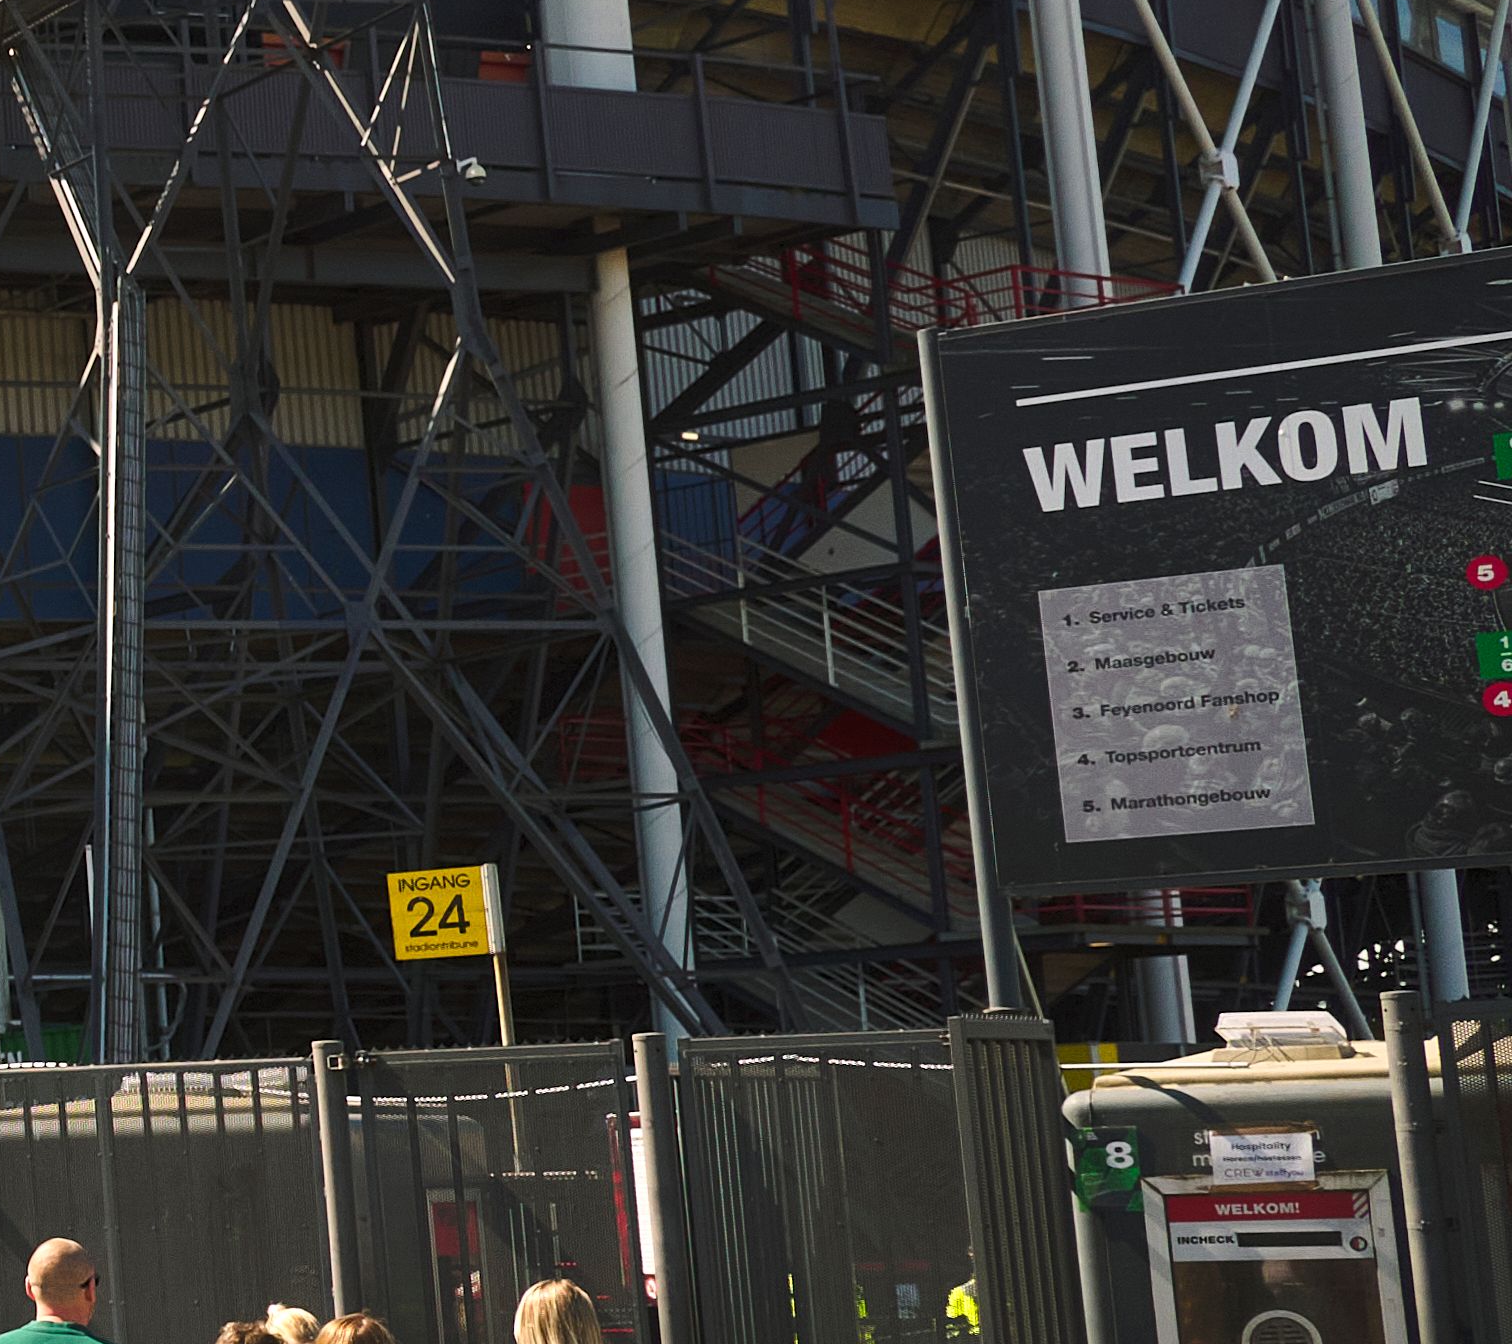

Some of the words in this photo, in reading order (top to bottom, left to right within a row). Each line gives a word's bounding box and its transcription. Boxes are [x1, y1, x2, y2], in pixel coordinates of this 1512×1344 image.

[1022, 397, 1427, 512] WELKOM
[1477, 564, 1494, 582] 5
[1063, 614, 1080, 626] 1.
[1089, 606, 1155, 624] Service
[1160, 603, 1173, 617] &
[1177, 597, 1245, 615] Tickets
[1067, 660, 1085, 673] 2.
[1095, 648, 1215, 670] Maasgebouw
[1072, 707, 1091, 719] 3.
[1100, 696, 1195, 717] Feyenoord
[1201, 690, 1280, 708] Fanshop
[1493, 690, 1512, 707] 4
[1077, 753, 1096, 766] 4.
[1105, 740, 1261, 765] Topsportcentrum
[1082, 800, 1101, 812] 5.
[1111, 788, 1270, 810] Marathongebouw
[398, 874, 470, 893] INGANG
[407, 894, 470, 937] 24
[405, 940, 478, 953] stadiontribune
[1106, 1141, 1134, 1169] 8
[1231, 1142, 1291, 1152] Hospitality
[1215, 1202, 1300, 1216] WELKOM!
[1177, 1235, 1235, 1245] INCHECK
